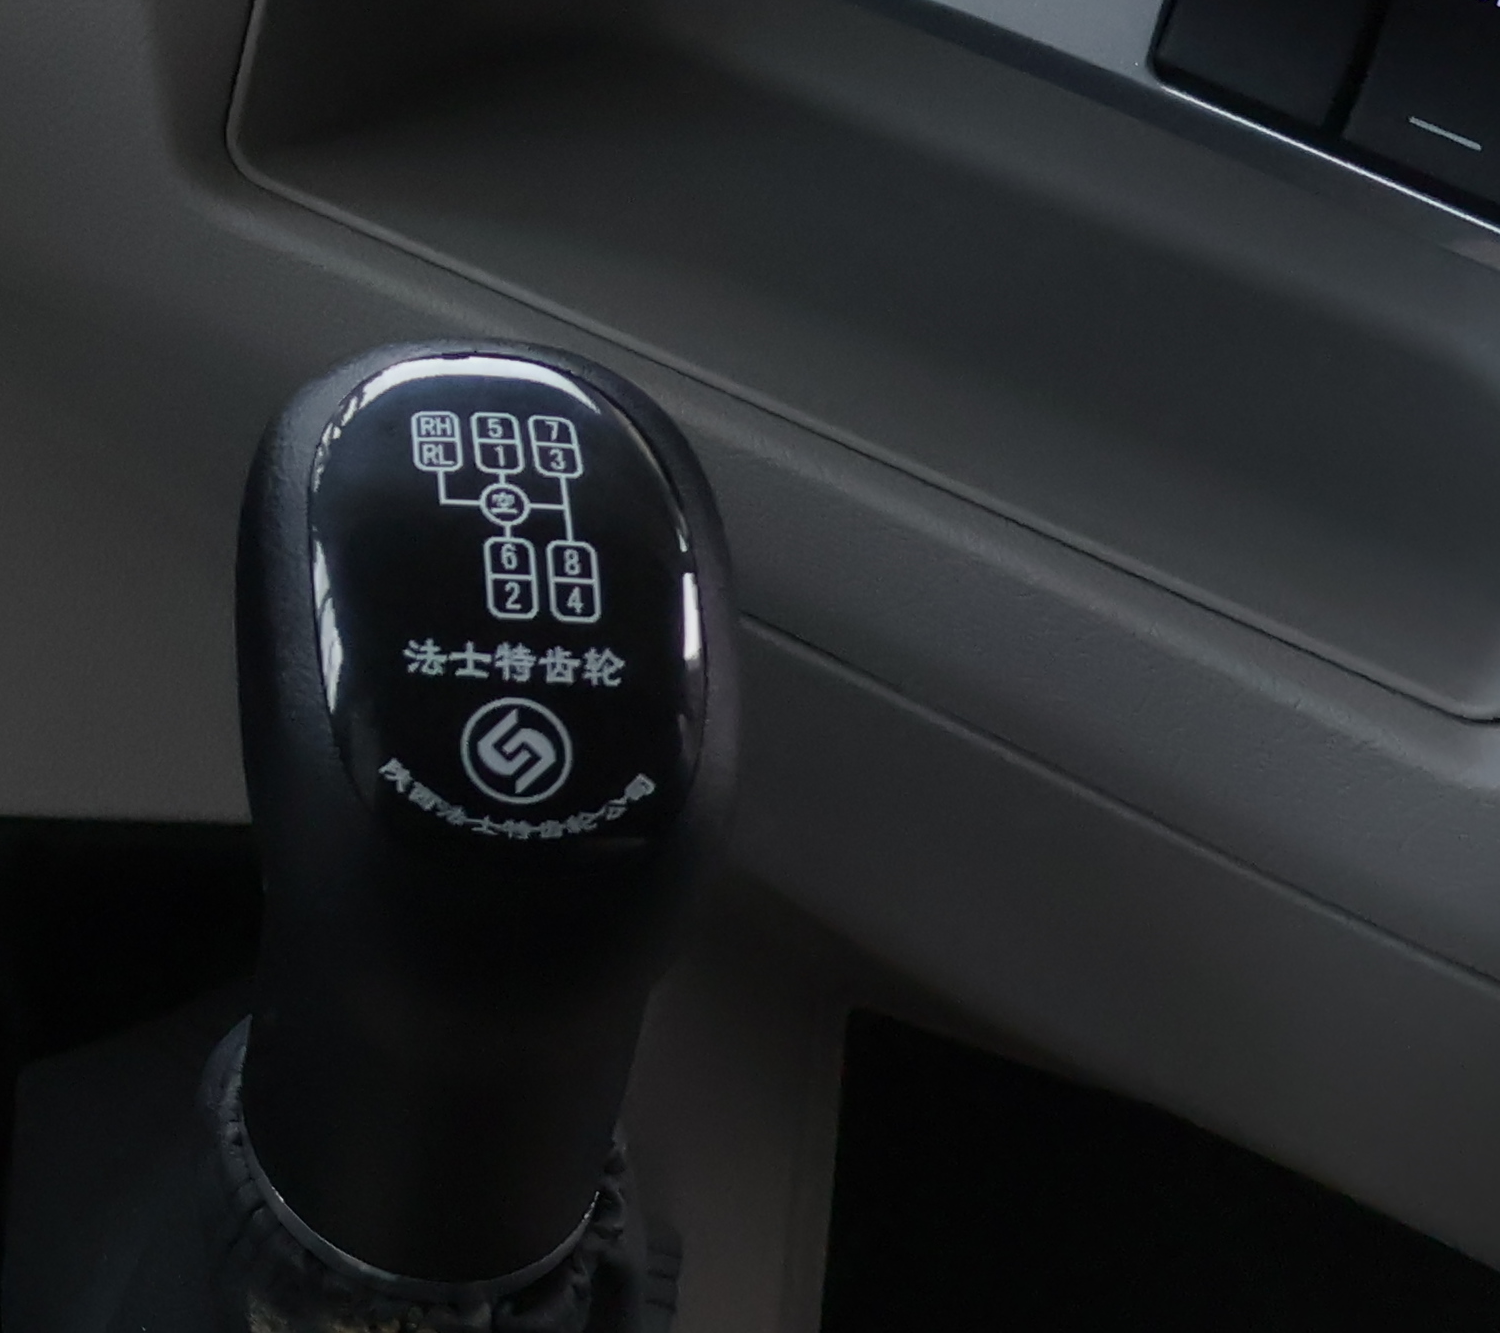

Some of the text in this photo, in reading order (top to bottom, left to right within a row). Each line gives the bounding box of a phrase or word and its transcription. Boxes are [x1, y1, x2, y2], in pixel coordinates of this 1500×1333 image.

[419, 417, 560, 440] RH 5 7
[421, 443, 566, 470] RL 1 3
[501, 544, 581, 576] 6 8
[504, 582, 585, 614] 2 4
[402, 638, 626, 688] 法士特齿轮
